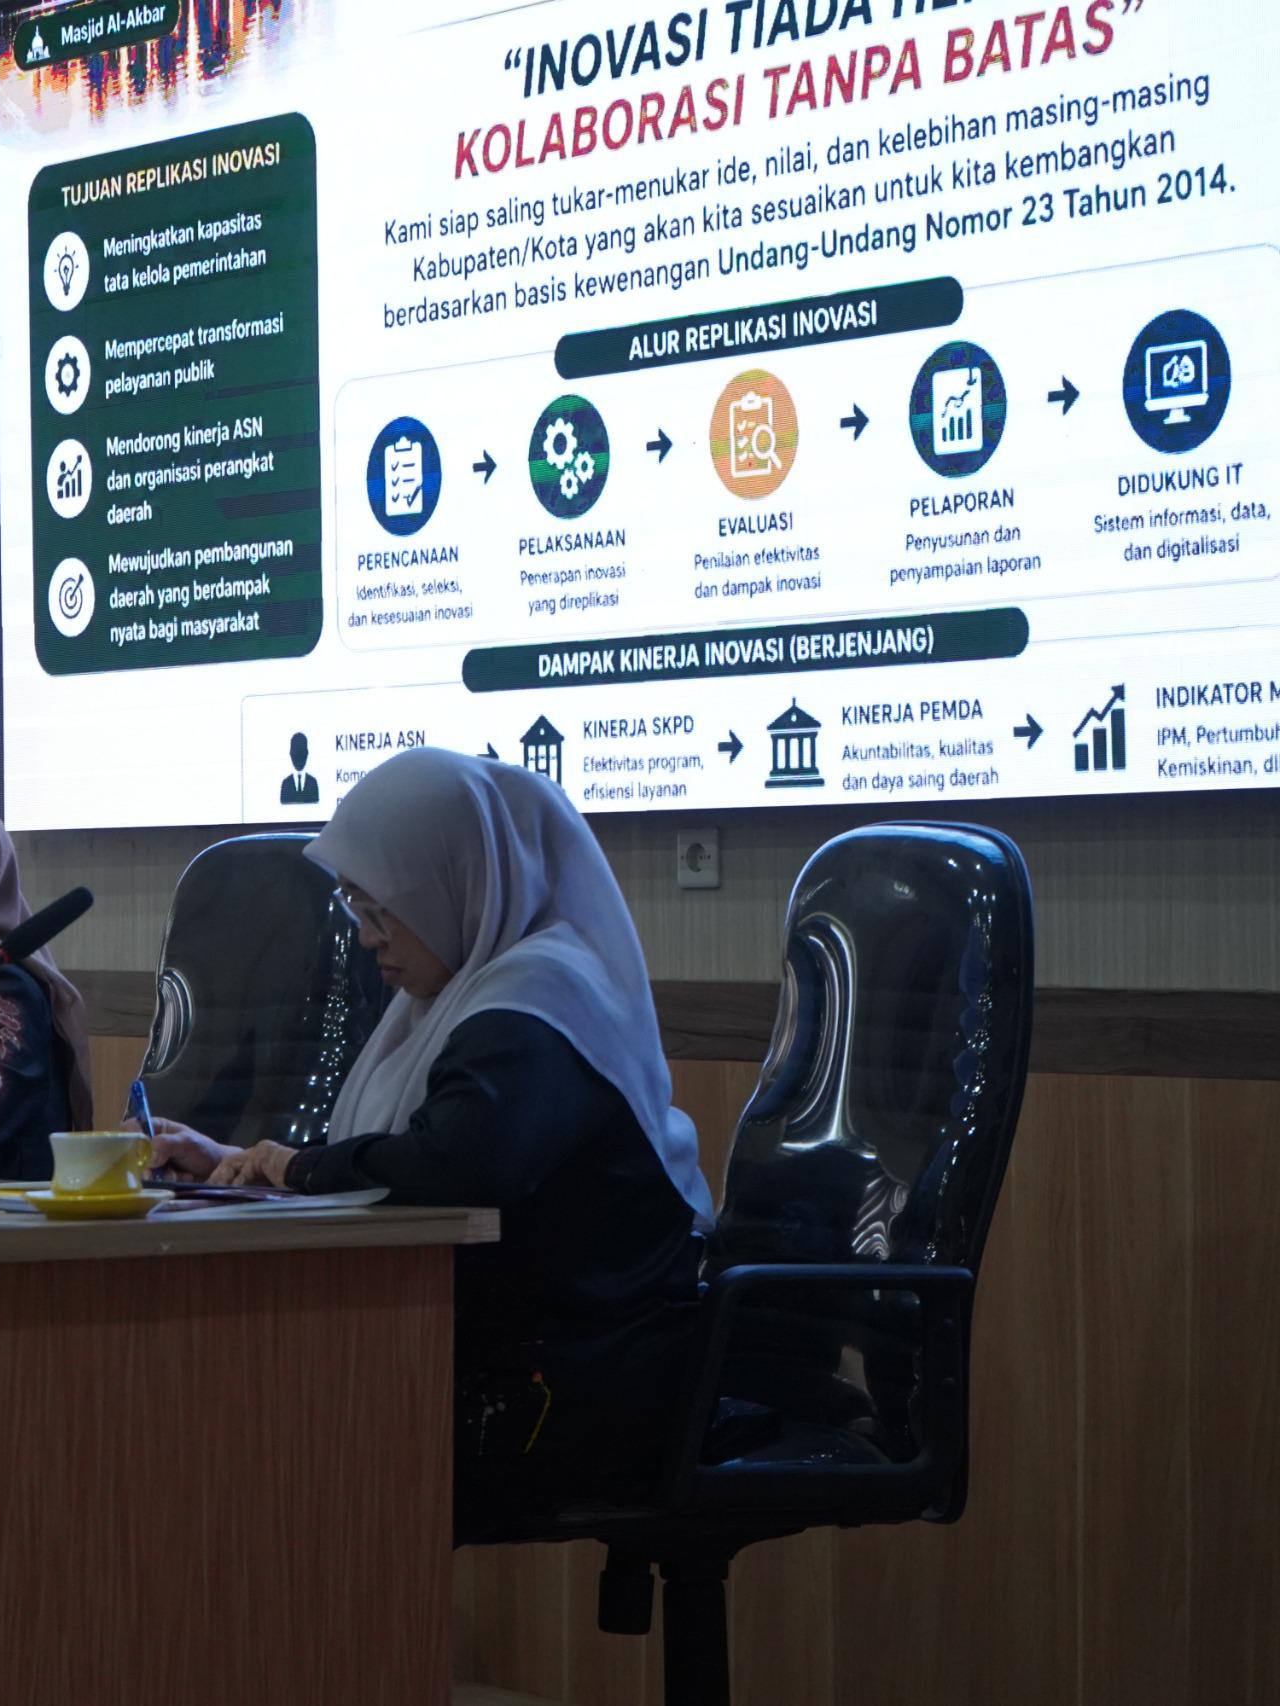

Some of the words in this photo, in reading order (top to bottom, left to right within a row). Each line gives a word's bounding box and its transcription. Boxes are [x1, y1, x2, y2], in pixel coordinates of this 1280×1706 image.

[61, 18, 104, 46] Masjid
[107, 5, 166, 33] Al-Akbar
[726, 0, 872, 54] TIADA
[455, 74, 745, 179] KOLABORASI
[764, 38, 922, 119] TANPA
[385, 213, 432, 246] Kami
[439, 208, 478, 237] siap
[486, 197, 545, 226] saling
[552, 165, 709, 217] tukar-menukar
[717, 155, 756, 186] ide,
[766, 142, 818, 179] nilai,
[828, 135, 869, 166] dan
[879, 114, 996, 156] kelebihan
[1006, 73, 1209, 133] masing-masing
[61, 175, 122, 208] TUJUAN
[126, 157, 207, 194] REPLIKASI
[212, 142, 280, 176] INOVASI
[413, 230, 577, 282] Kabupaten/Kota
[585, 223, 636, 260] yang
[644, 211, 694, 243] akan
[703, 201, 742, 233] kita
[752, 183, 866, 226] sesuaikan
[875, 165, 941, 203] untuk
[952, 157, 995, 189] kita
[1005, 128, 1175, 179] kembangkan
[104, 226, 194, 258] Meningkatkan
[198, 212, 262, 242] kapasitas
[383, 289, 506, 328] berdasarkan
[515, 277, 566, 308] basis
[575, 258, 709, 298] kewenangan
[718, 223, 916, 276] Undang-Undang
[926, 204, 1013, 241] Nomor
[1022, 194, 1054, 226] 23
[1064, 181, 1146, 219] Tahun
[1157, 162, 1236, 205] 2014.
[105, 274, 129, 293] tata
[133, 263, 170, 288] kelola
[173, 248, 266, 285] pemerintahan
[105, 329, 195, 360] Mempercepat
[198, 312, 284, 345] transformasi
[629, 330, 680, 360] ALUR
[686, 314, 787, 352] REPLIKASI
[793, 299, 877, 337] INOVASI
[105, 369, 171, 399] pelayanan
[175, 359, 215, 389] publik
[106, 431, 180, 456] Mendorong
[184, 422, 229, 447] kinerja
[233, 416, 263, 439] ASN
[107, 471, 131, 491] dan
[135, 459, 201, 491] organisasi
[205, 450, 274, 483] perangkat
[1118, 466, 1219, 496] DIDUKUNG
[1226, 463, 1243, 485] IT
[107, 500, 152, 525] daerah
[910, 488, 1014, 517] PELAPORAN
[1094, 514, 1144, 533] Sistem
[1149, 503, 1225, 528] informasi,
[1231, 501, 1270, 521] data,
[719, 513, 793, 537] EVALUASI
[906, 531, 990, 553] Penyusunan
[994, 526, 1020, 543] dan
[108, 548, 191, 575] Mewujudkan
[195, 539, 293, 569] pembangunan
[519, 529, 625, 556] PELAKSANAAN
[1124, 542, 1152, 561] dan
[1157, 533, 1240, 562] digitalisasi
[358, 546, 458, 571] PERENCANAAN
[694, 550, 749, 571] Penilaian
[754, 545, 820, 565] efektivitas
[890, 560, 982, 586] penyampaian
[987, 555, 1041, 577] laporan
[520, 569, 581, 586] Penerapan
[585, 561, 625, 580] inovasi
[695, 581, 718, 598] dan
[722, 576, 772, 597] dampak
[777, 573, 821, 591] inovasi
[110, 583, 154, 609] daerah
[158, 586, 190, 609] yang
[193, 573, 270, 600] berdampak
[356, 581, 418, 600] Identifikasi,
[422, 577, 462, 595] seleksi,
[529, 598, 555, 616] yang
[560, 589, 618, 610] direplikasi
[110, 621, 146, 647] nyata
[150, 617, 178, 643] bagi
[181, 610, 260, 639] masyarakat
[348, 612, 367, 627] dan
[371, 606, 430, 625] kesesuaian
[435, 602, 473, 620] inovasi
[539, 654, 615, 678] DAMPAK
[620, 644, 698, 672] KINERJA
[705, 638, 783, 665] INOVASI
[790, 625, 934, 663] (BERJENJANG)
[1157, 681, 1262, 709] INDIKATOR
[842, 703, 914, 725] KINERJA
[920, 699, 983, 721] PEMDA
[336, 732, 392, 752] KINERJA
[397, 730, 425, 748] ASN
[583, 719, 646, 739] KINERJA
[652, 715, 694, 735] SKPD
[1157, 726, 1191, 747] IPM,
[583, 756, 644, 773] Efektivitas
[648, 755, 704, 774] program,
[842, 743, 935, 762] Akuntabilitas,
[939, 739, 995, 757] kualitas
[843, 772, 867, 791] dan
[871, 771, 904, 792] daya
[909, 768, 945, 791] saing
[949, 767, 999, 786] daerah
[1157, 755, 1257, 778] Kemiskinan,
[584, 780, 633, 800] efisiensi
[638, 781, 686, 800] layanan
